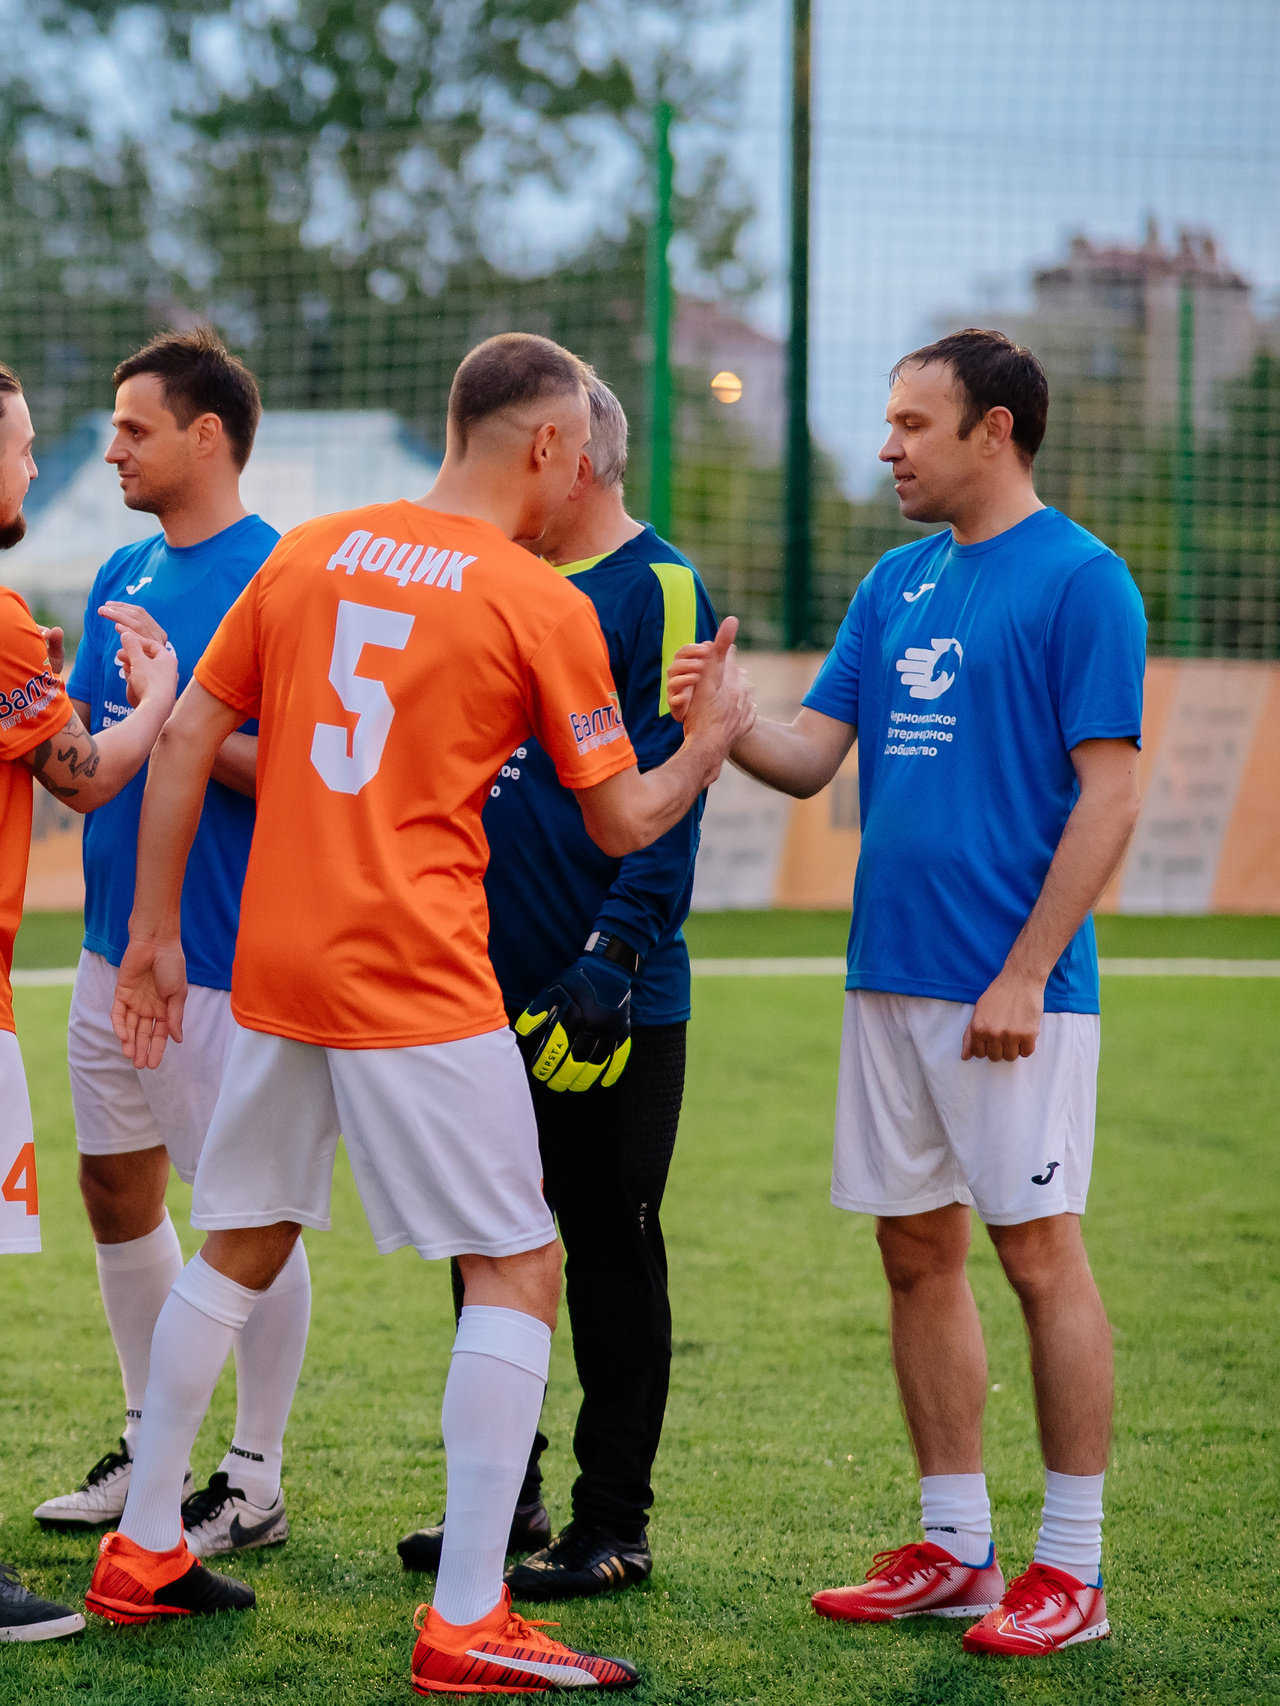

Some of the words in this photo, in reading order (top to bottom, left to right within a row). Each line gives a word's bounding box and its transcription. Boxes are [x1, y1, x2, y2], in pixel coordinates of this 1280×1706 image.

[326, 529, 479, 592] ДОЦИК
[309, 599, 416, 796] 5
[537, 1043, 564, 1077] KIPSTA
